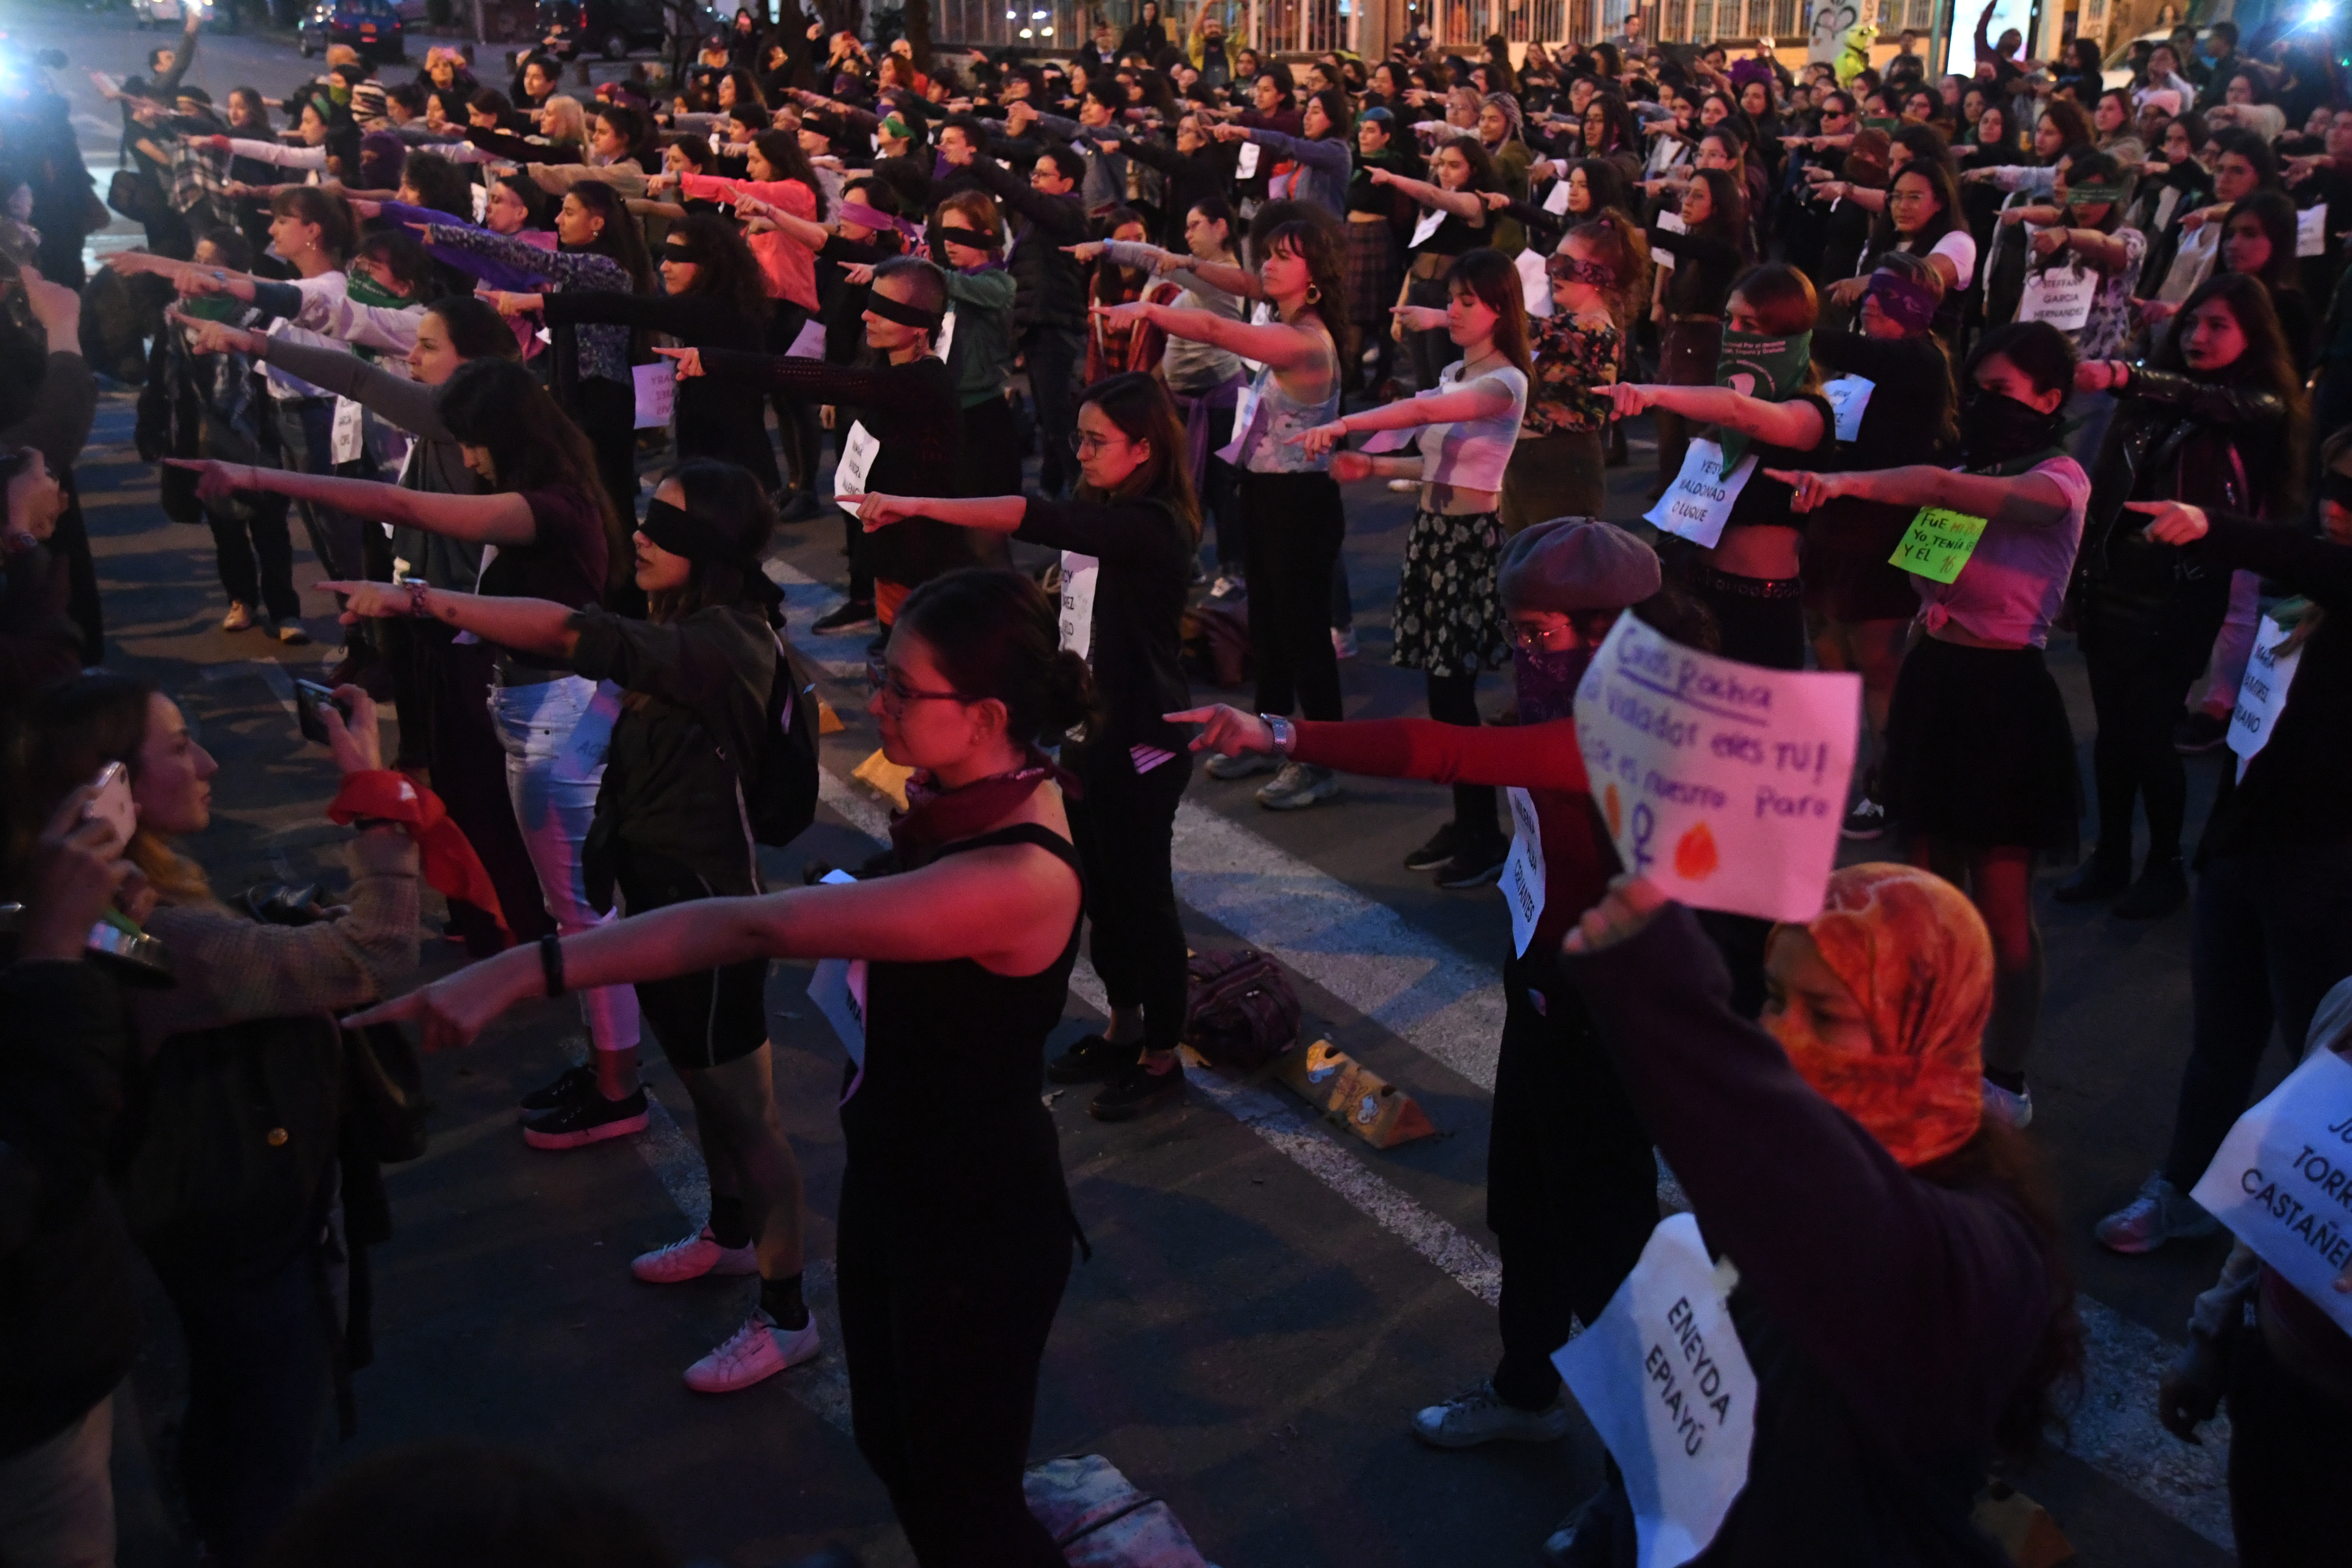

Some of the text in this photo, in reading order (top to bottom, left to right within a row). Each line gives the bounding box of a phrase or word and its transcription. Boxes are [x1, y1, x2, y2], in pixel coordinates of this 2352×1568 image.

[1678, 502, 1708, 522] LUQUE
[1904, 543, 1914, 557] Y
[1527, 838, 1537, 876] ALBA
[1514, 858, 1535, 923] CERVANTES
[2293, 1144, 2352, 1213] TORR
[2241, 1168, 2352, 1271] CASTAÑE
[1666, 1295, 1731, 1426] ENEYDA
